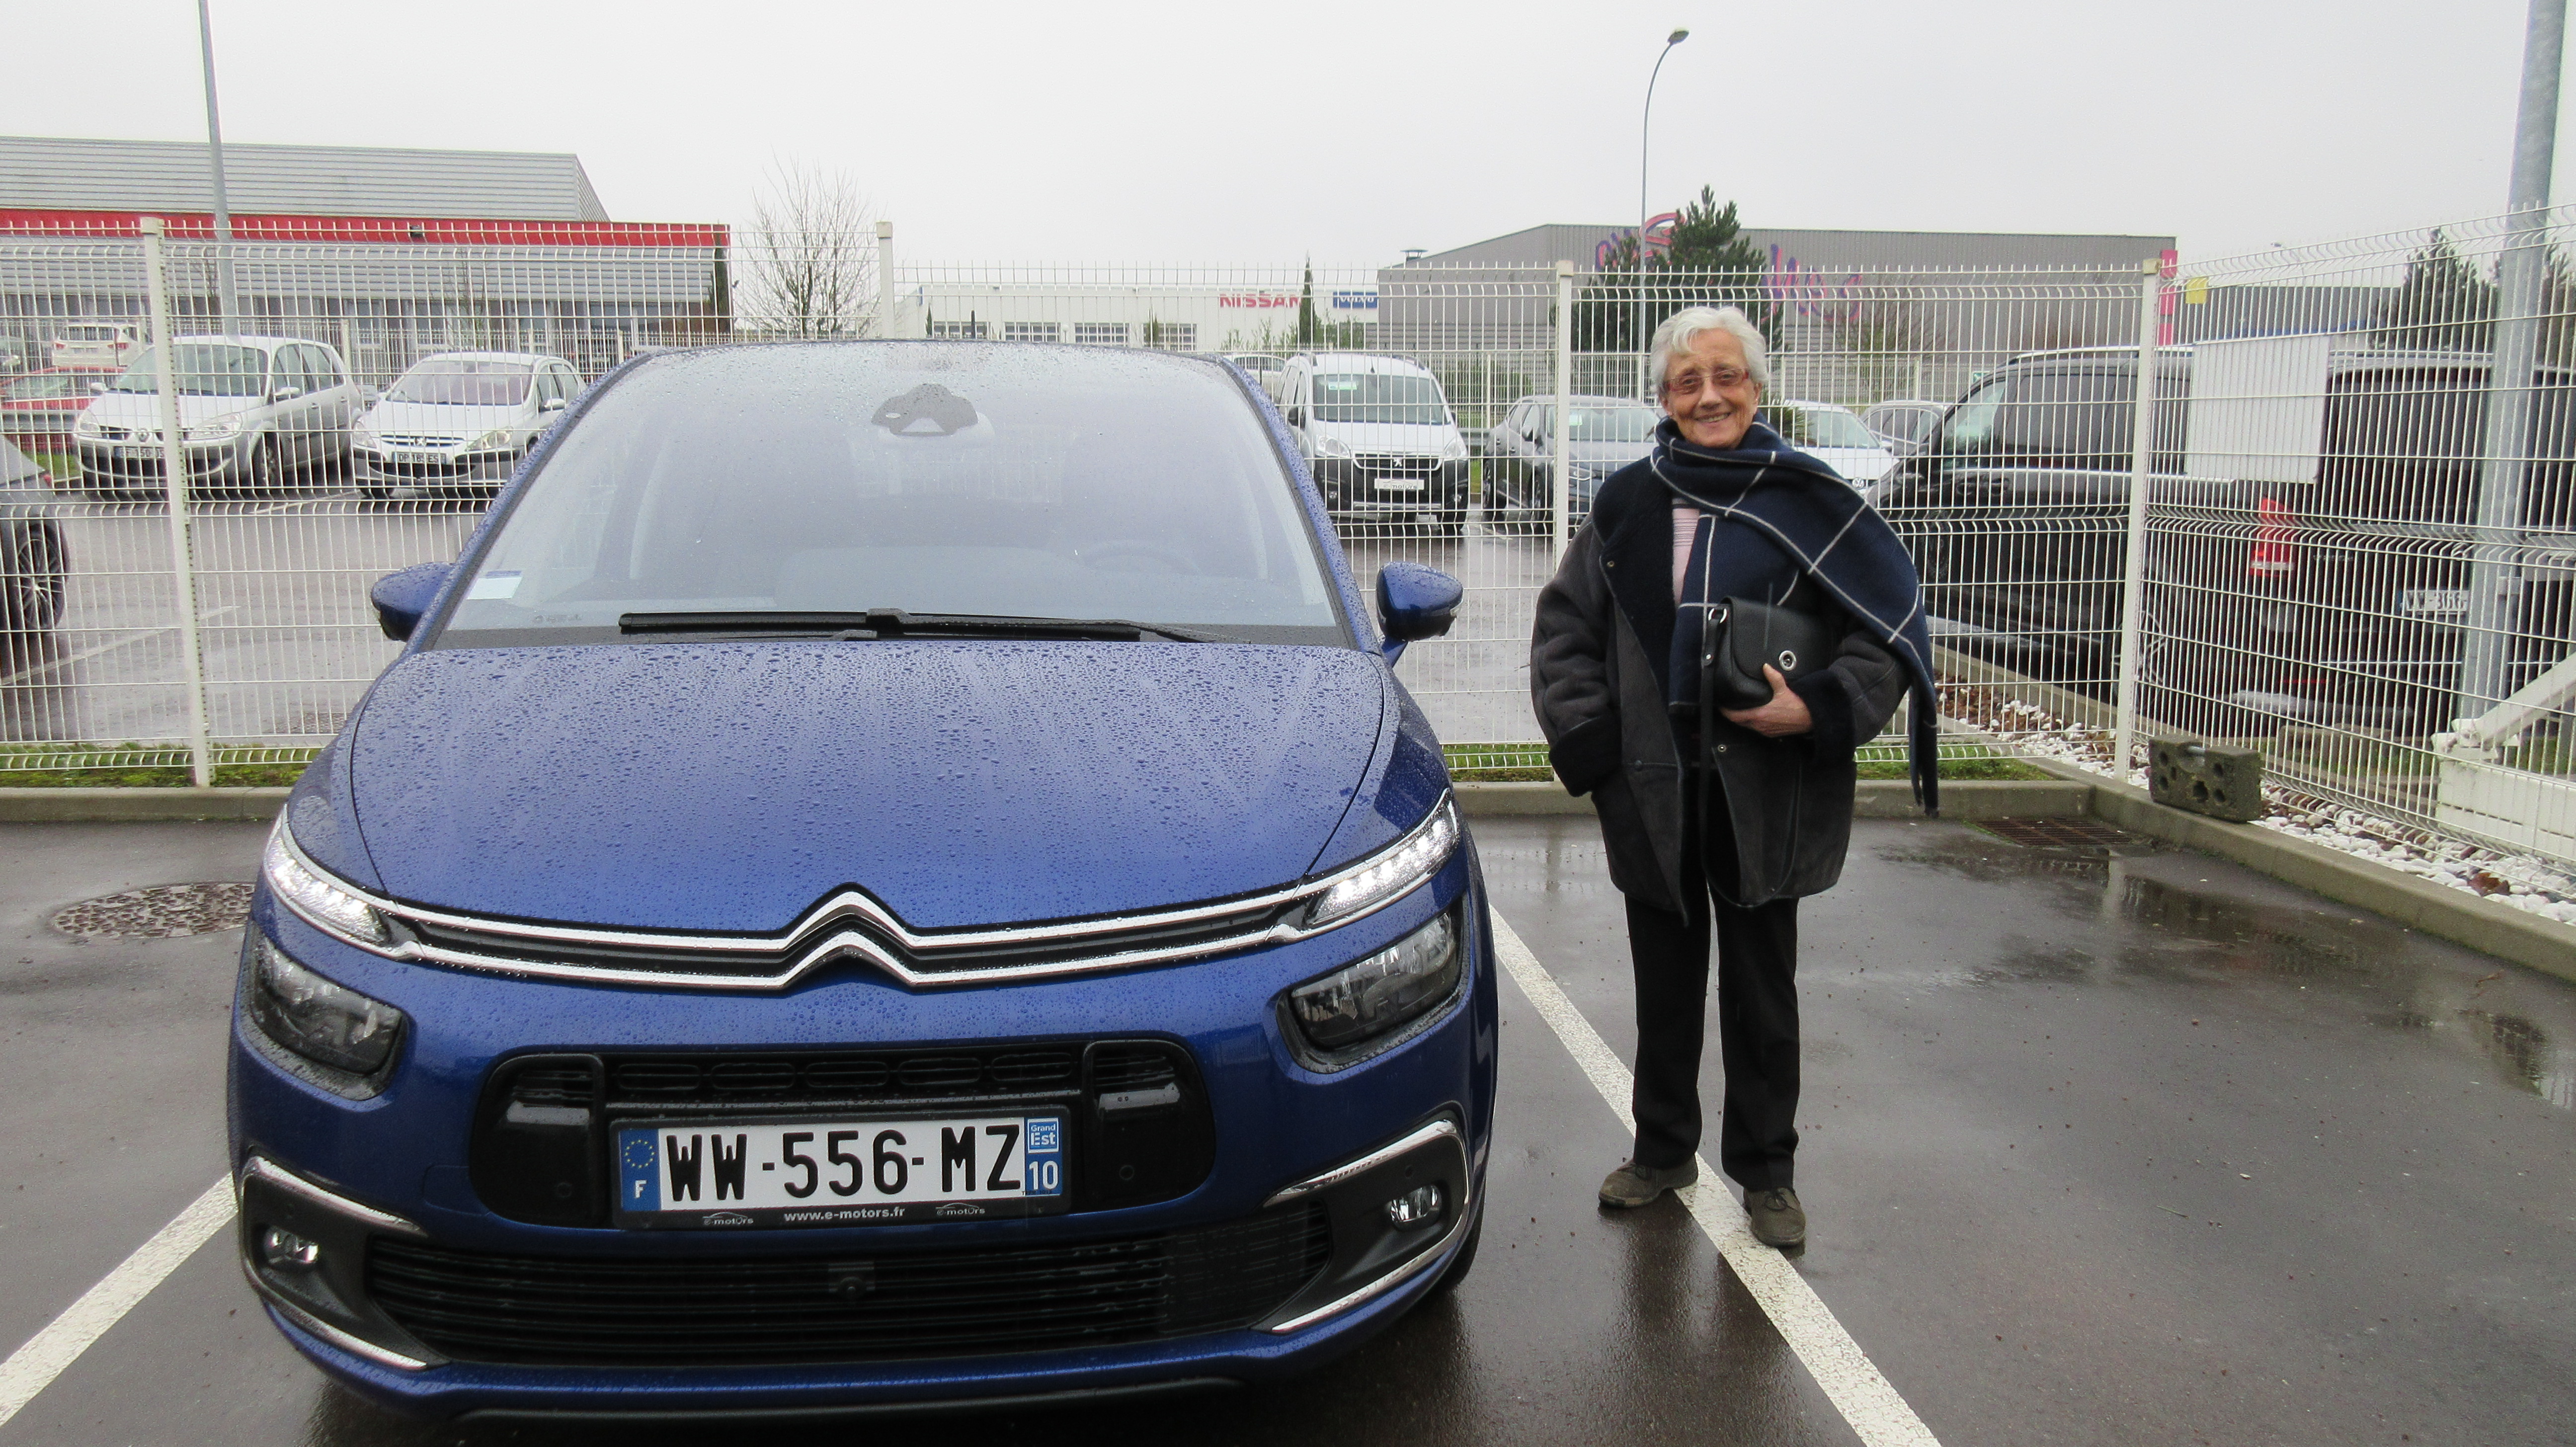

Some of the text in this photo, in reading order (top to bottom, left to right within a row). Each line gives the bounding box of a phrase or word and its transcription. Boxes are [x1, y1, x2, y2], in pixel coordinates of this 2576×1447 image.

[1219, 294, 1301, 308] NISSAN
[1031, 1124, 1056, 1132] Grand
[1031, 1131, 1056, 1146] Est
[1029, 1160, 1058, 1190] 10
[634, 1179, 647, 1199] F
[784, 1206, 906, 1222] www.e-motors.fr
